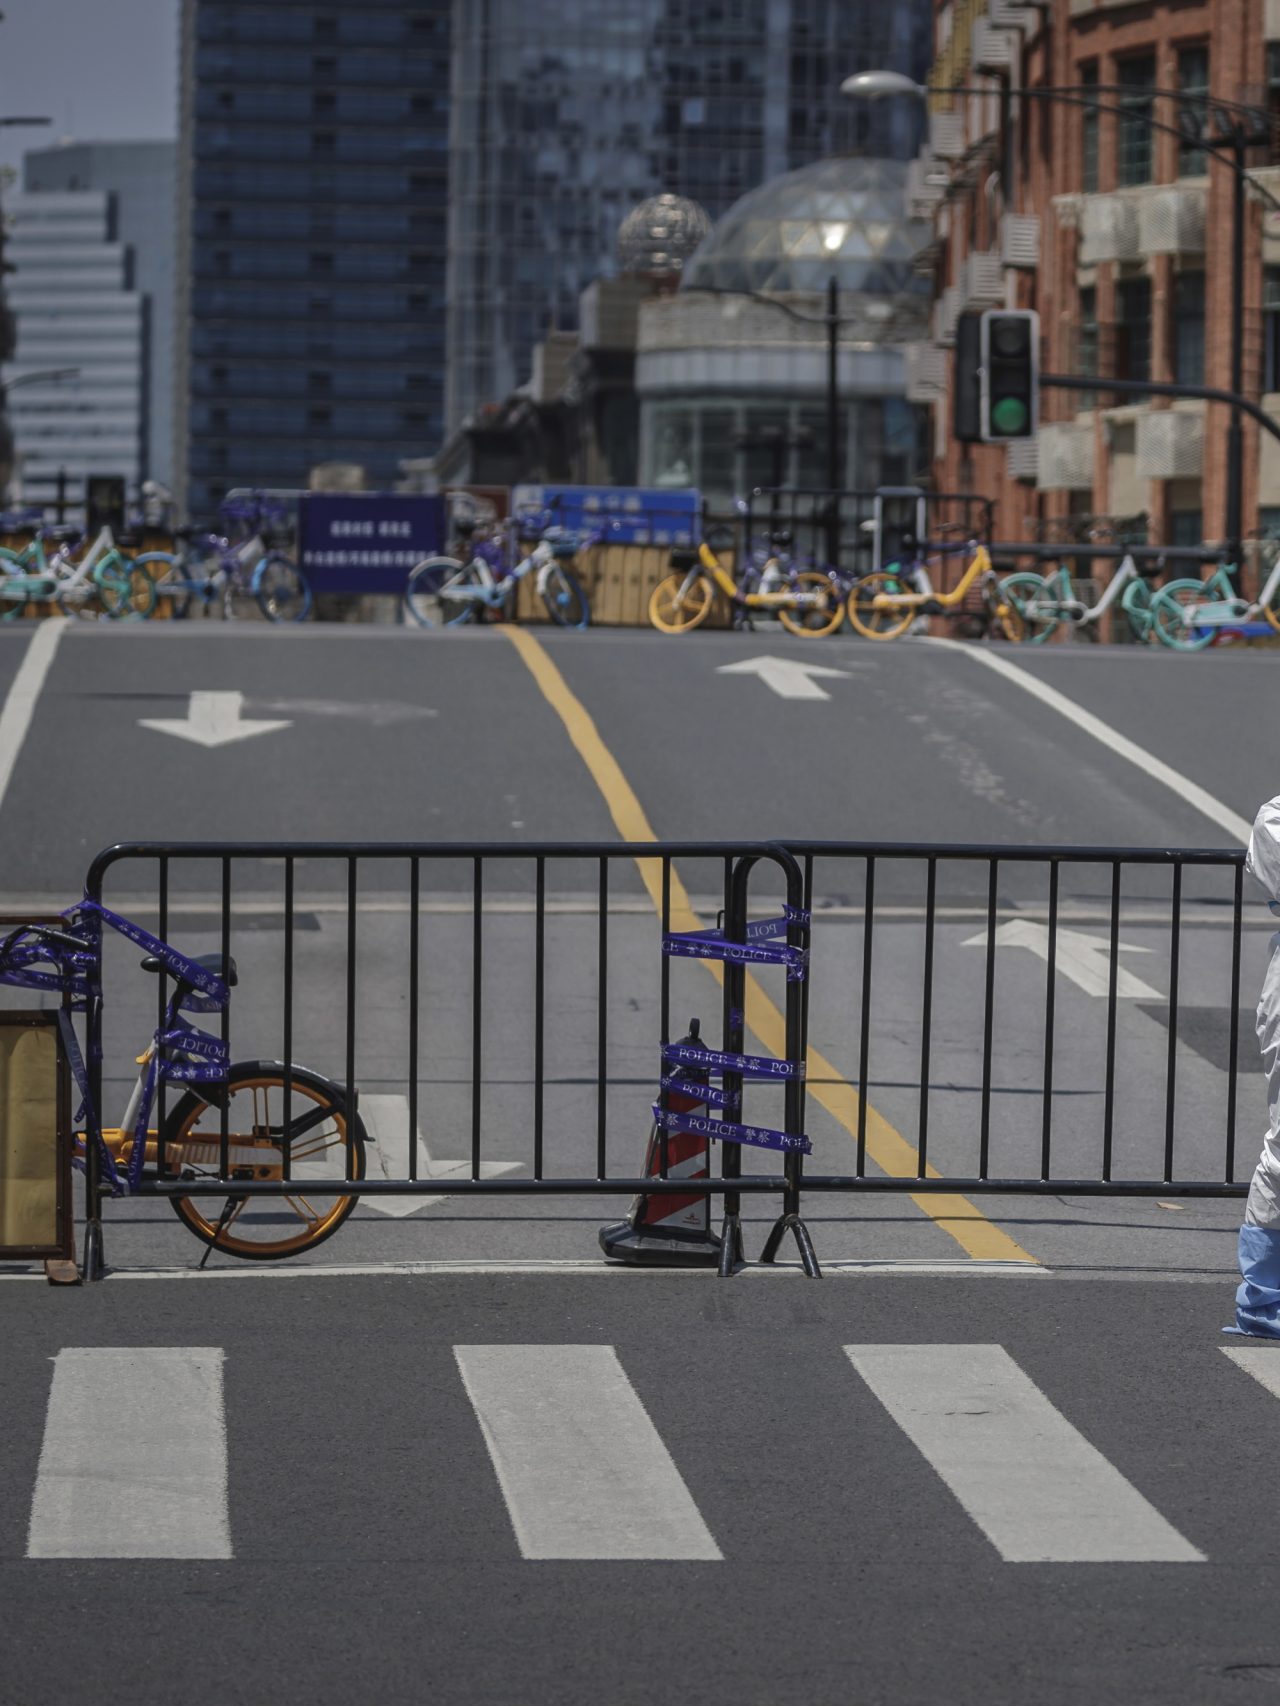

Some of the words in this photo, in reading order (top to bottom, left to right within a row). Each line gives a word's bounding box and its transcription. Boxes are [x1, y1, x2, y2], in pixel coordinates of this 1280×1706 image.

[722, 947, 772, 961] POLICE
[179, 1037, 226, 1058] POLICE
[678, 1048, 728, 1065] POLICE
[682, 1083, 728, 1104] POLICE
[688, 1117, 738, 1137] POLICE
